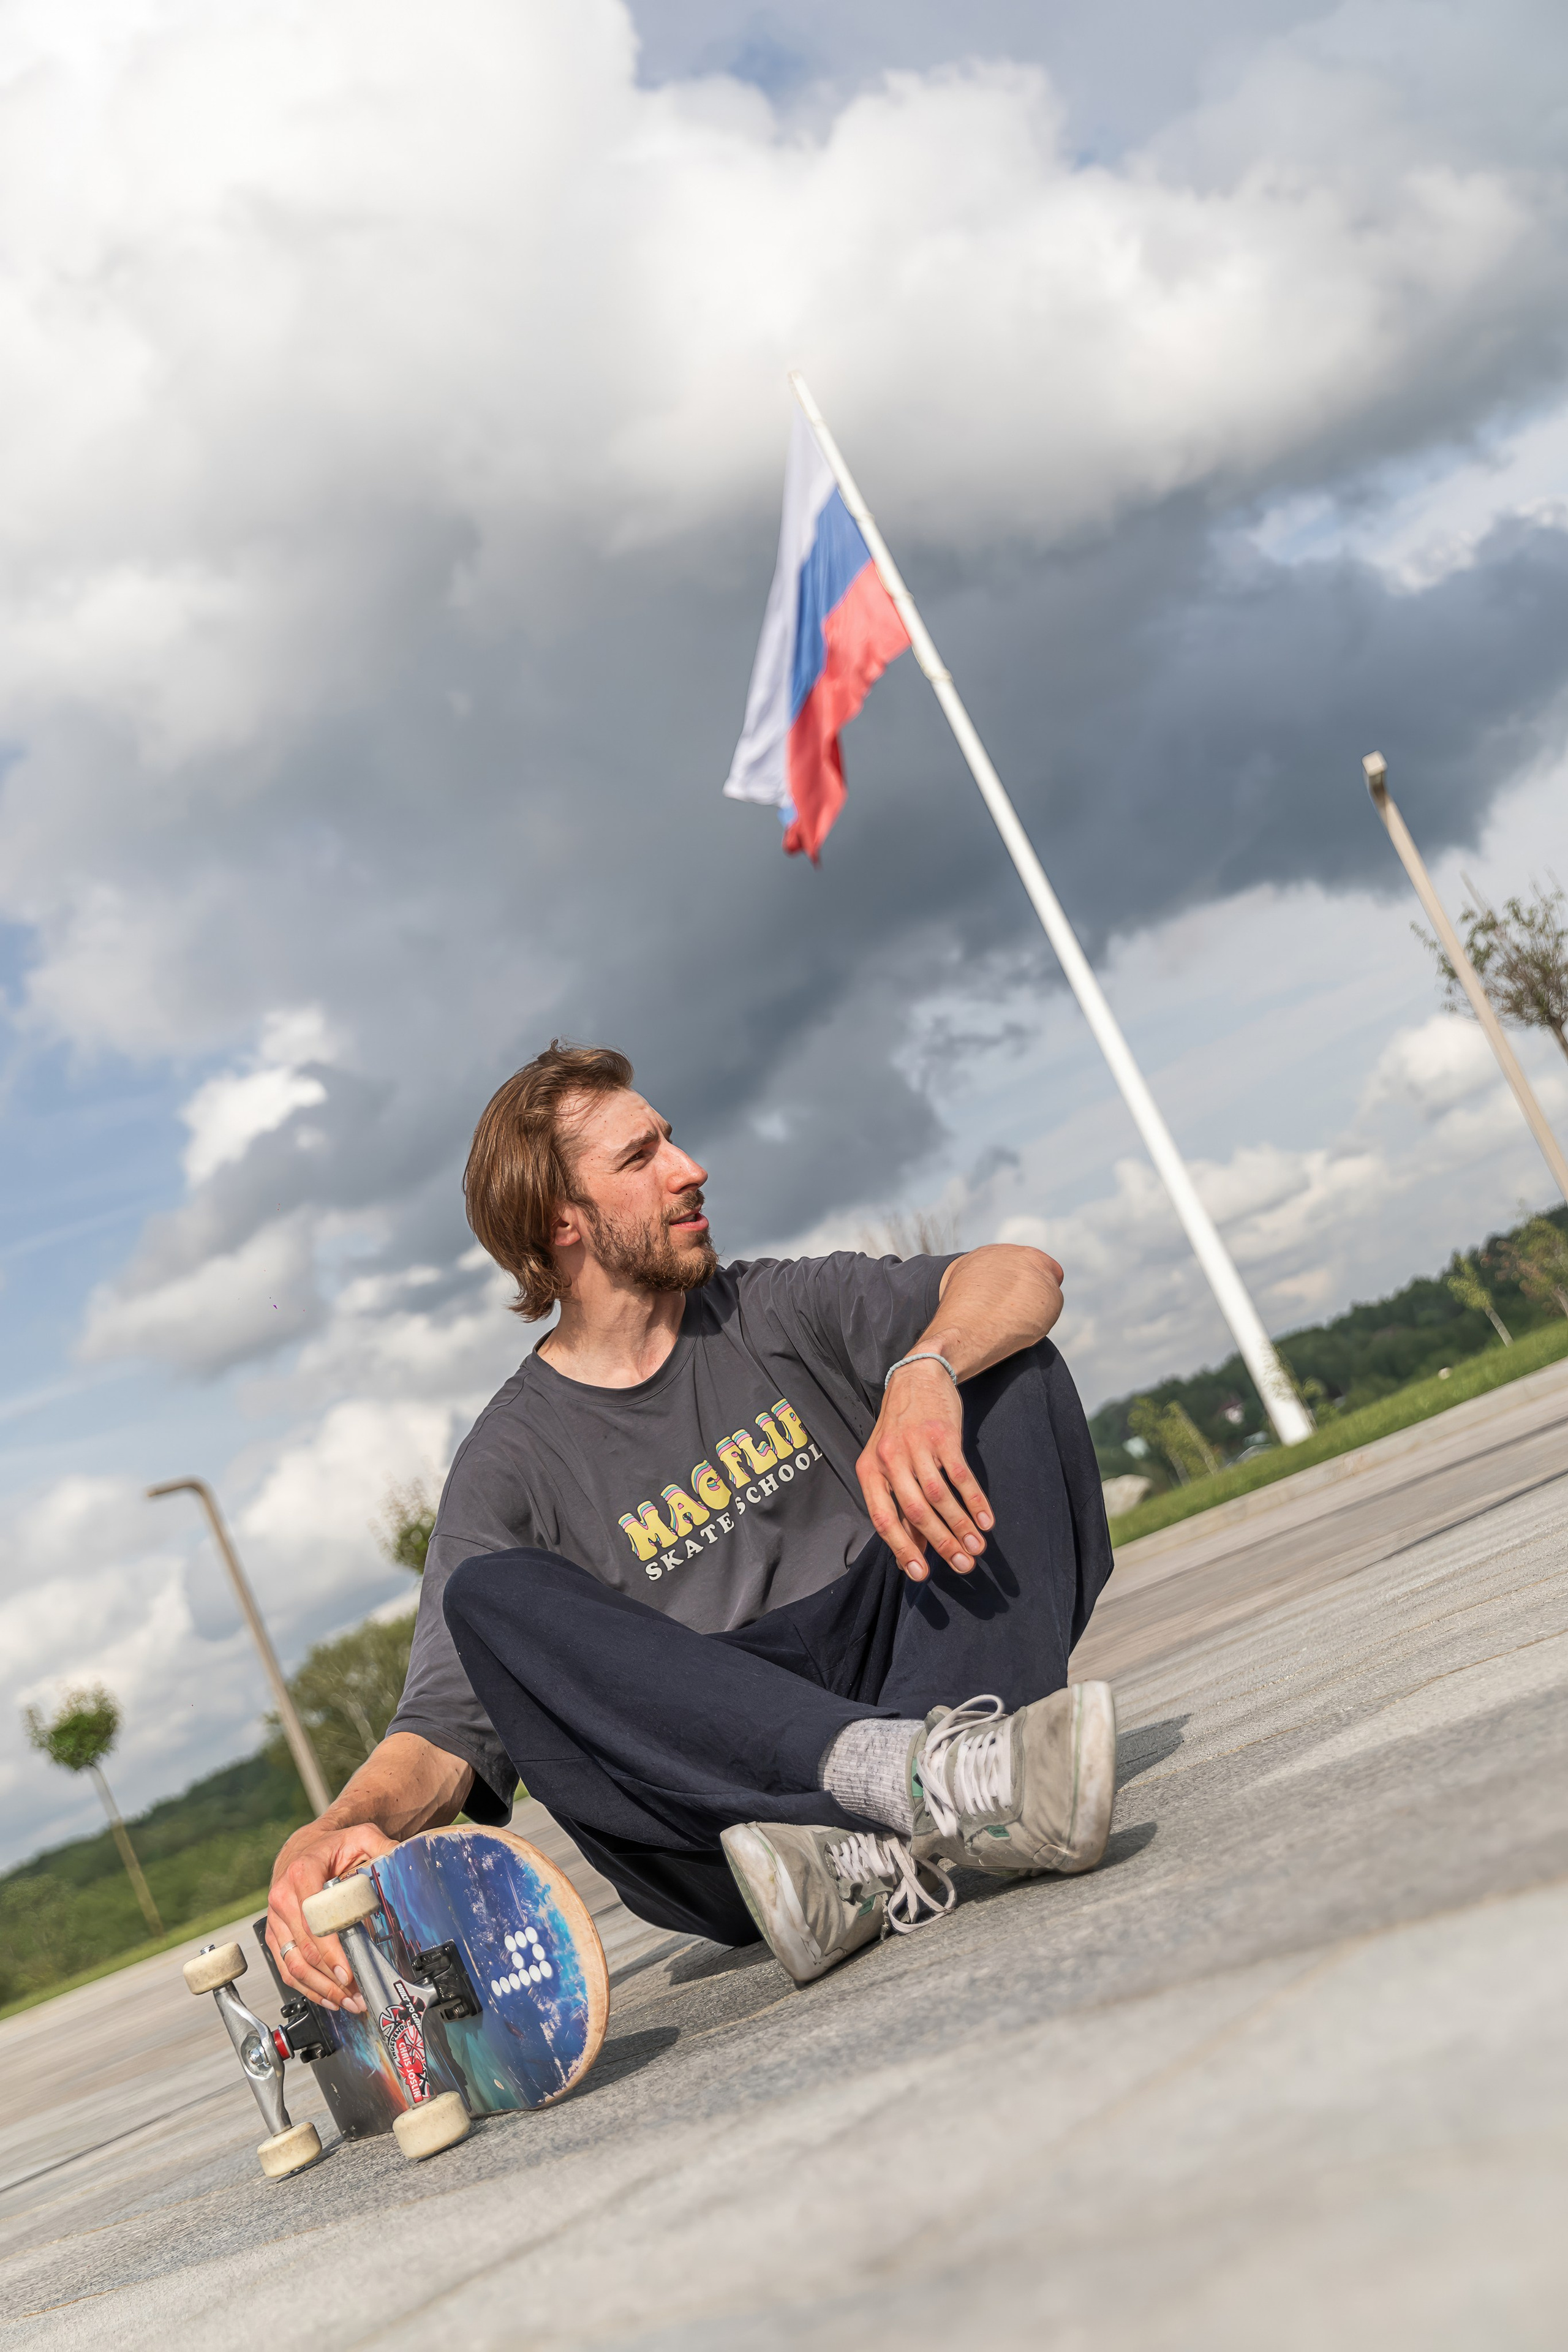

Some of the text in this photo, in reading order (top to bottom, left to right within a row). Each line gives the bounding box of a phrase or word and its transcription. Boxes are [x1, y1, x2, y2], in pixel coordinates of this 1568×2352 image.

[645, 1443, 823, 1581] SKATE SCHOOL
[395, 1983, 411, 2002] BUILT
[406, 2002, 415, 2013] TO
[399, 2042, 422, 2098] CHRIS JOSLIN
